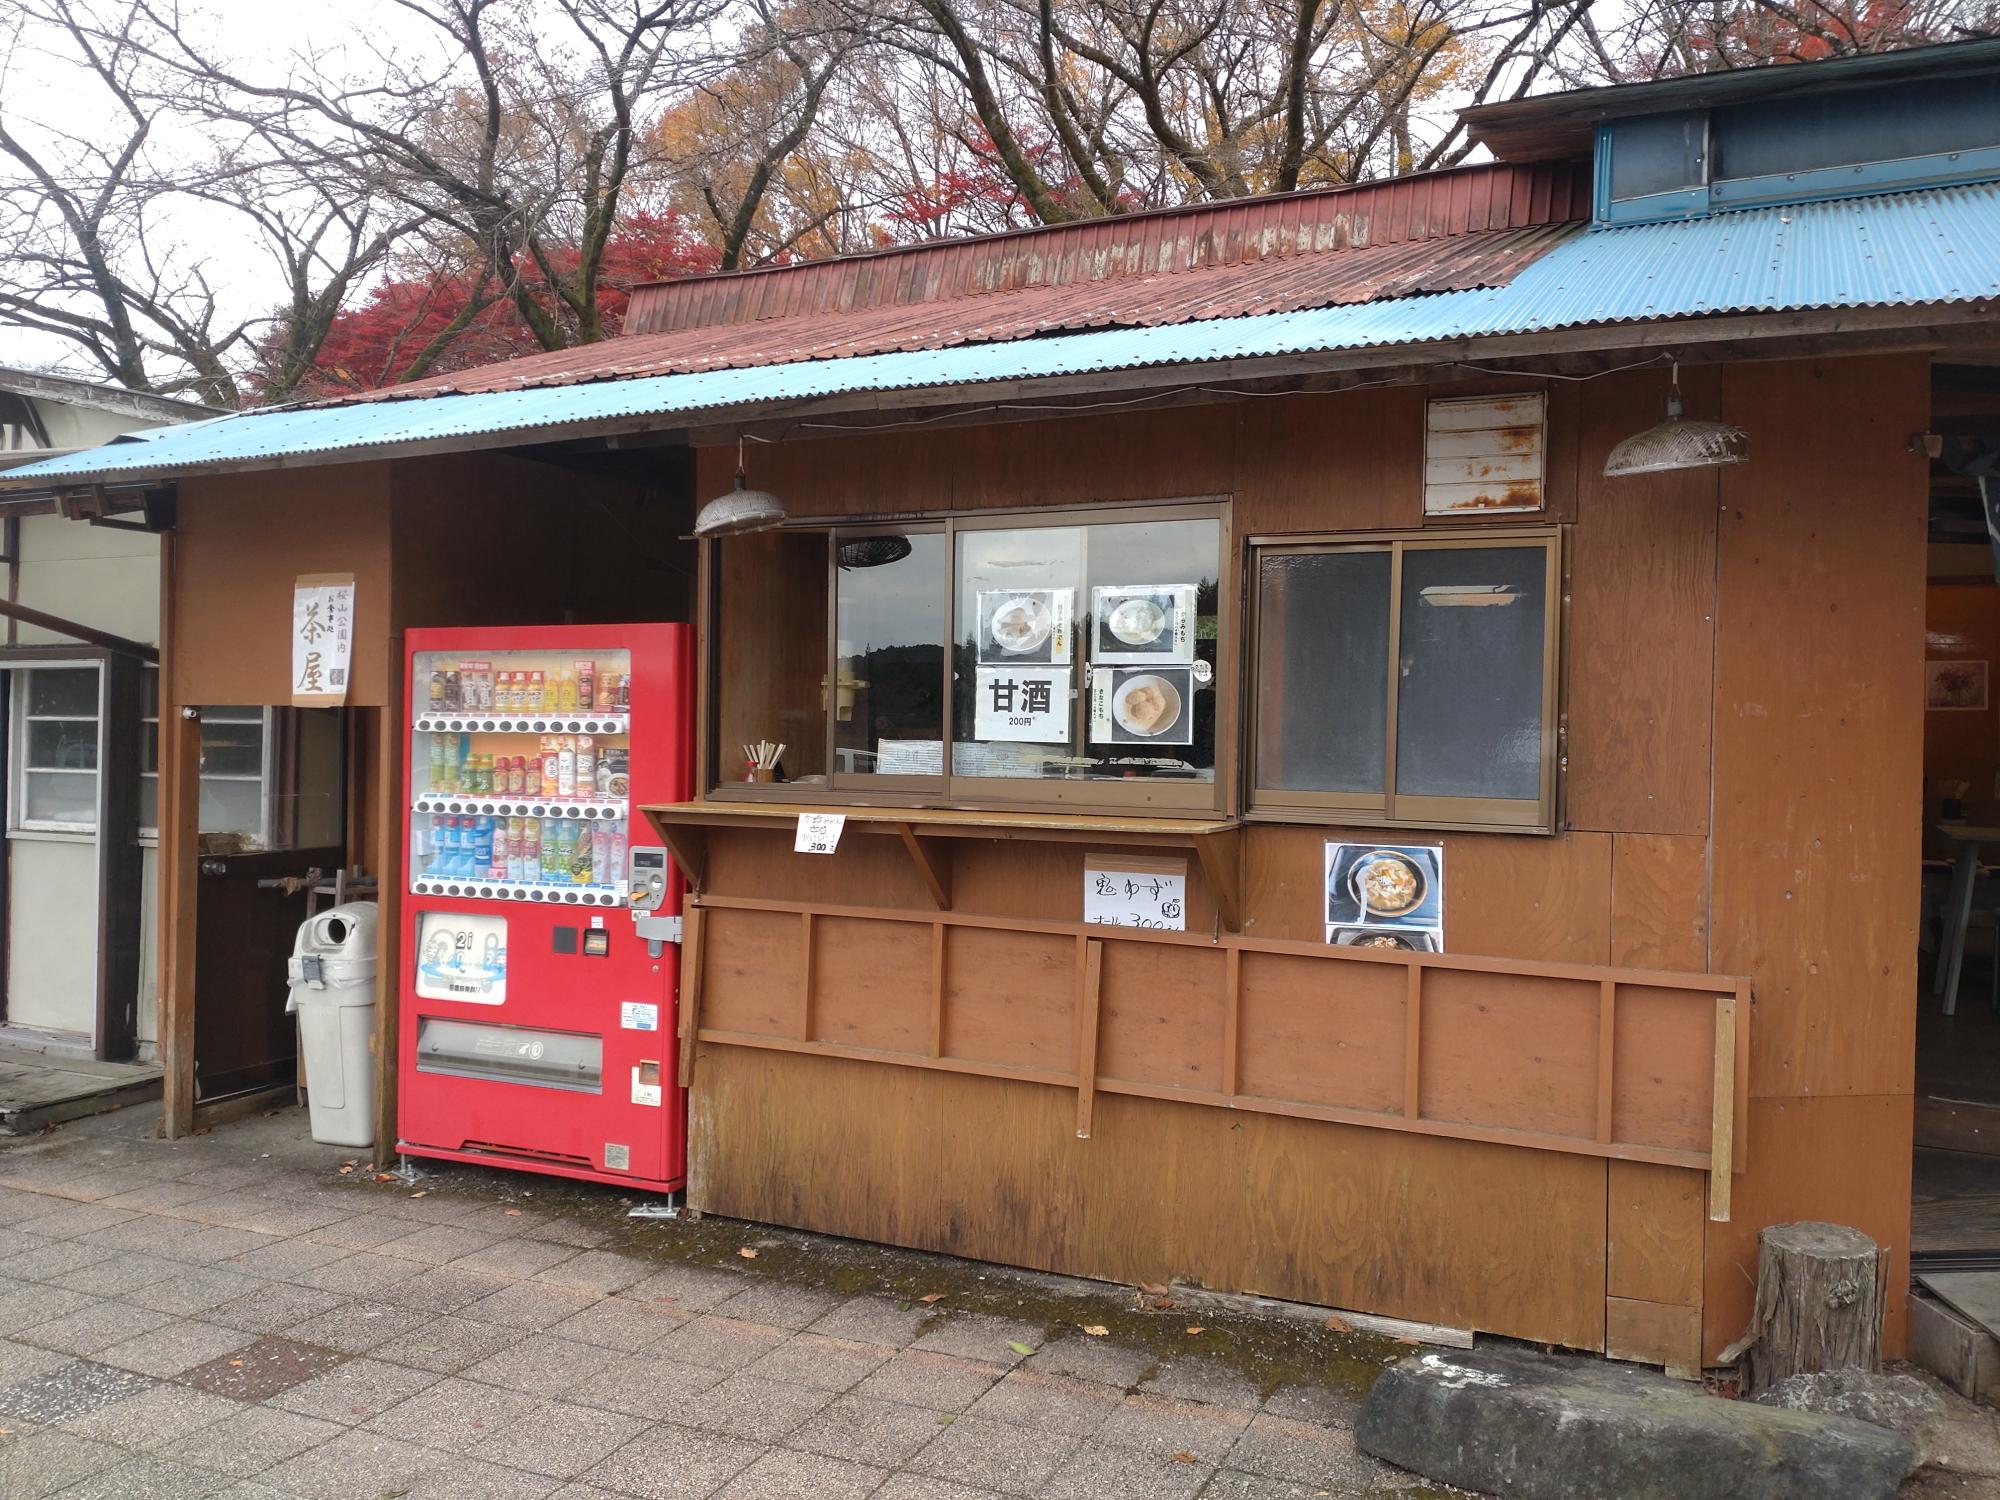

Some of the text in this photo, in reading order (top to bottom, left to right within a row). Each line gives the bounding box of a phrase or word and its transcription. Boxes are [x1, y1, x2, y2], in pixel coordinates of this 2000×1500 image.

[297, 602, 326, 692] 茶屋
[337, 590, 349, 654] 桜山公園内
[988, 678, 1053, 714] 甘酒
[1008, 717, 1032, 727] 200円
